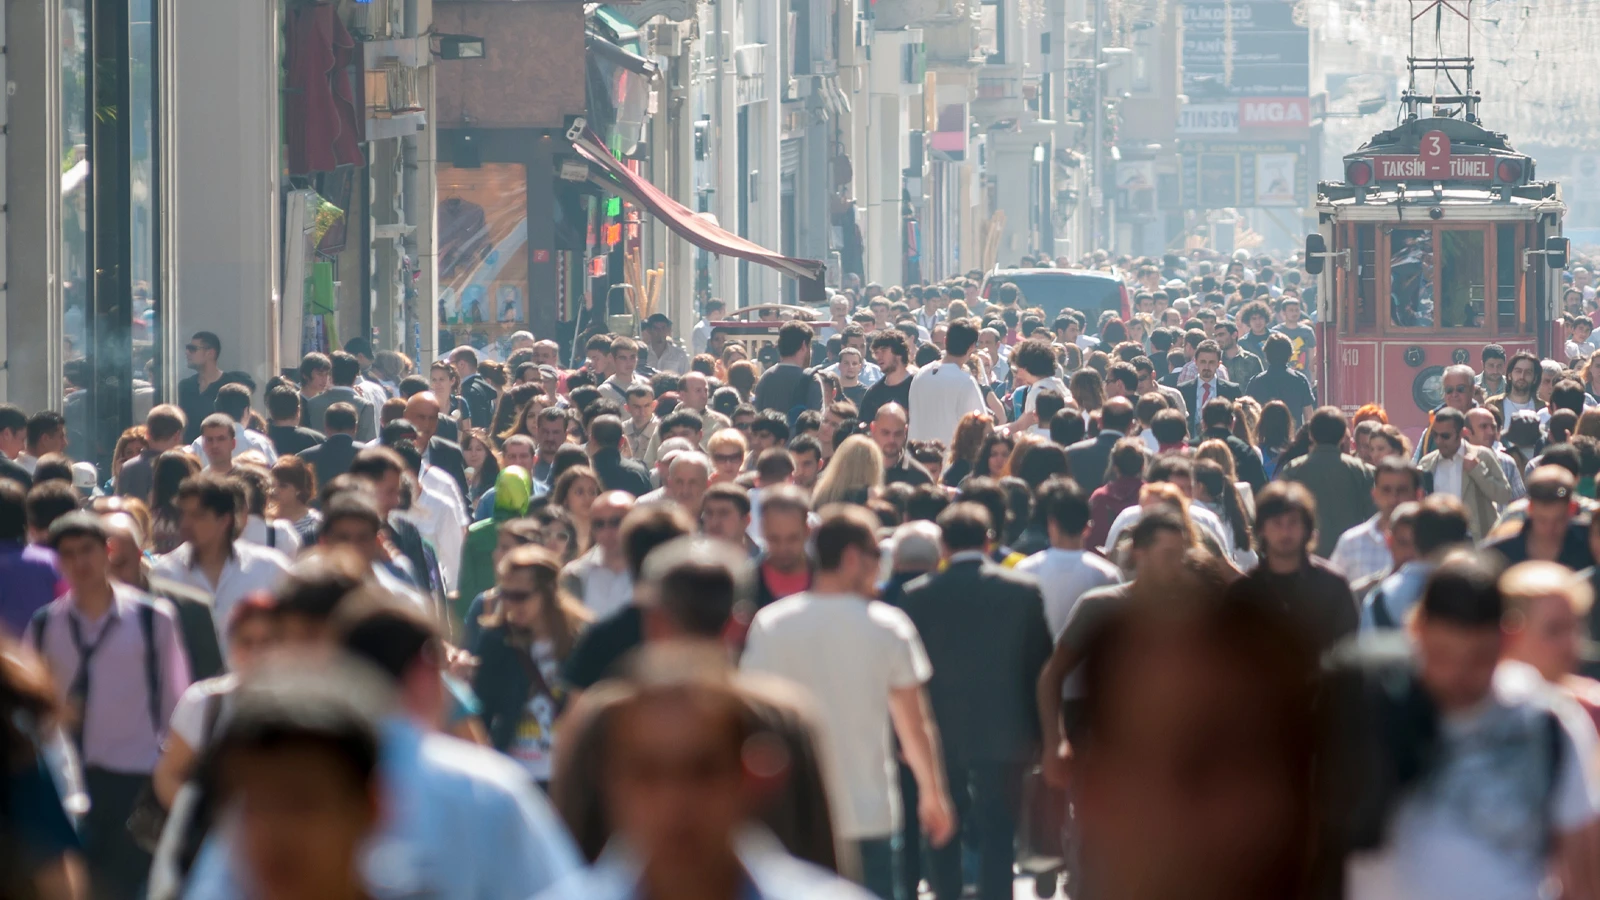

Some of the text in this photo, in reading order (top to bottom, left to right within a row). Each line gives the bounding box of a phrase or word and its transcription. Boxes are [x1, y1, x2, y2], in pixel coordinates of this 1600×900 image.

[1184, 5, 1251, 20] YLİKDZÜ
[1244, 102, 1303, 122] MGA
[1428, 136, 1441, 156] 3
[1382, 158, 1426, 177] TAKSİM
[1449, 158, 1490, 177] TÜNEL
[1341, 348, 1359, 366] 410
